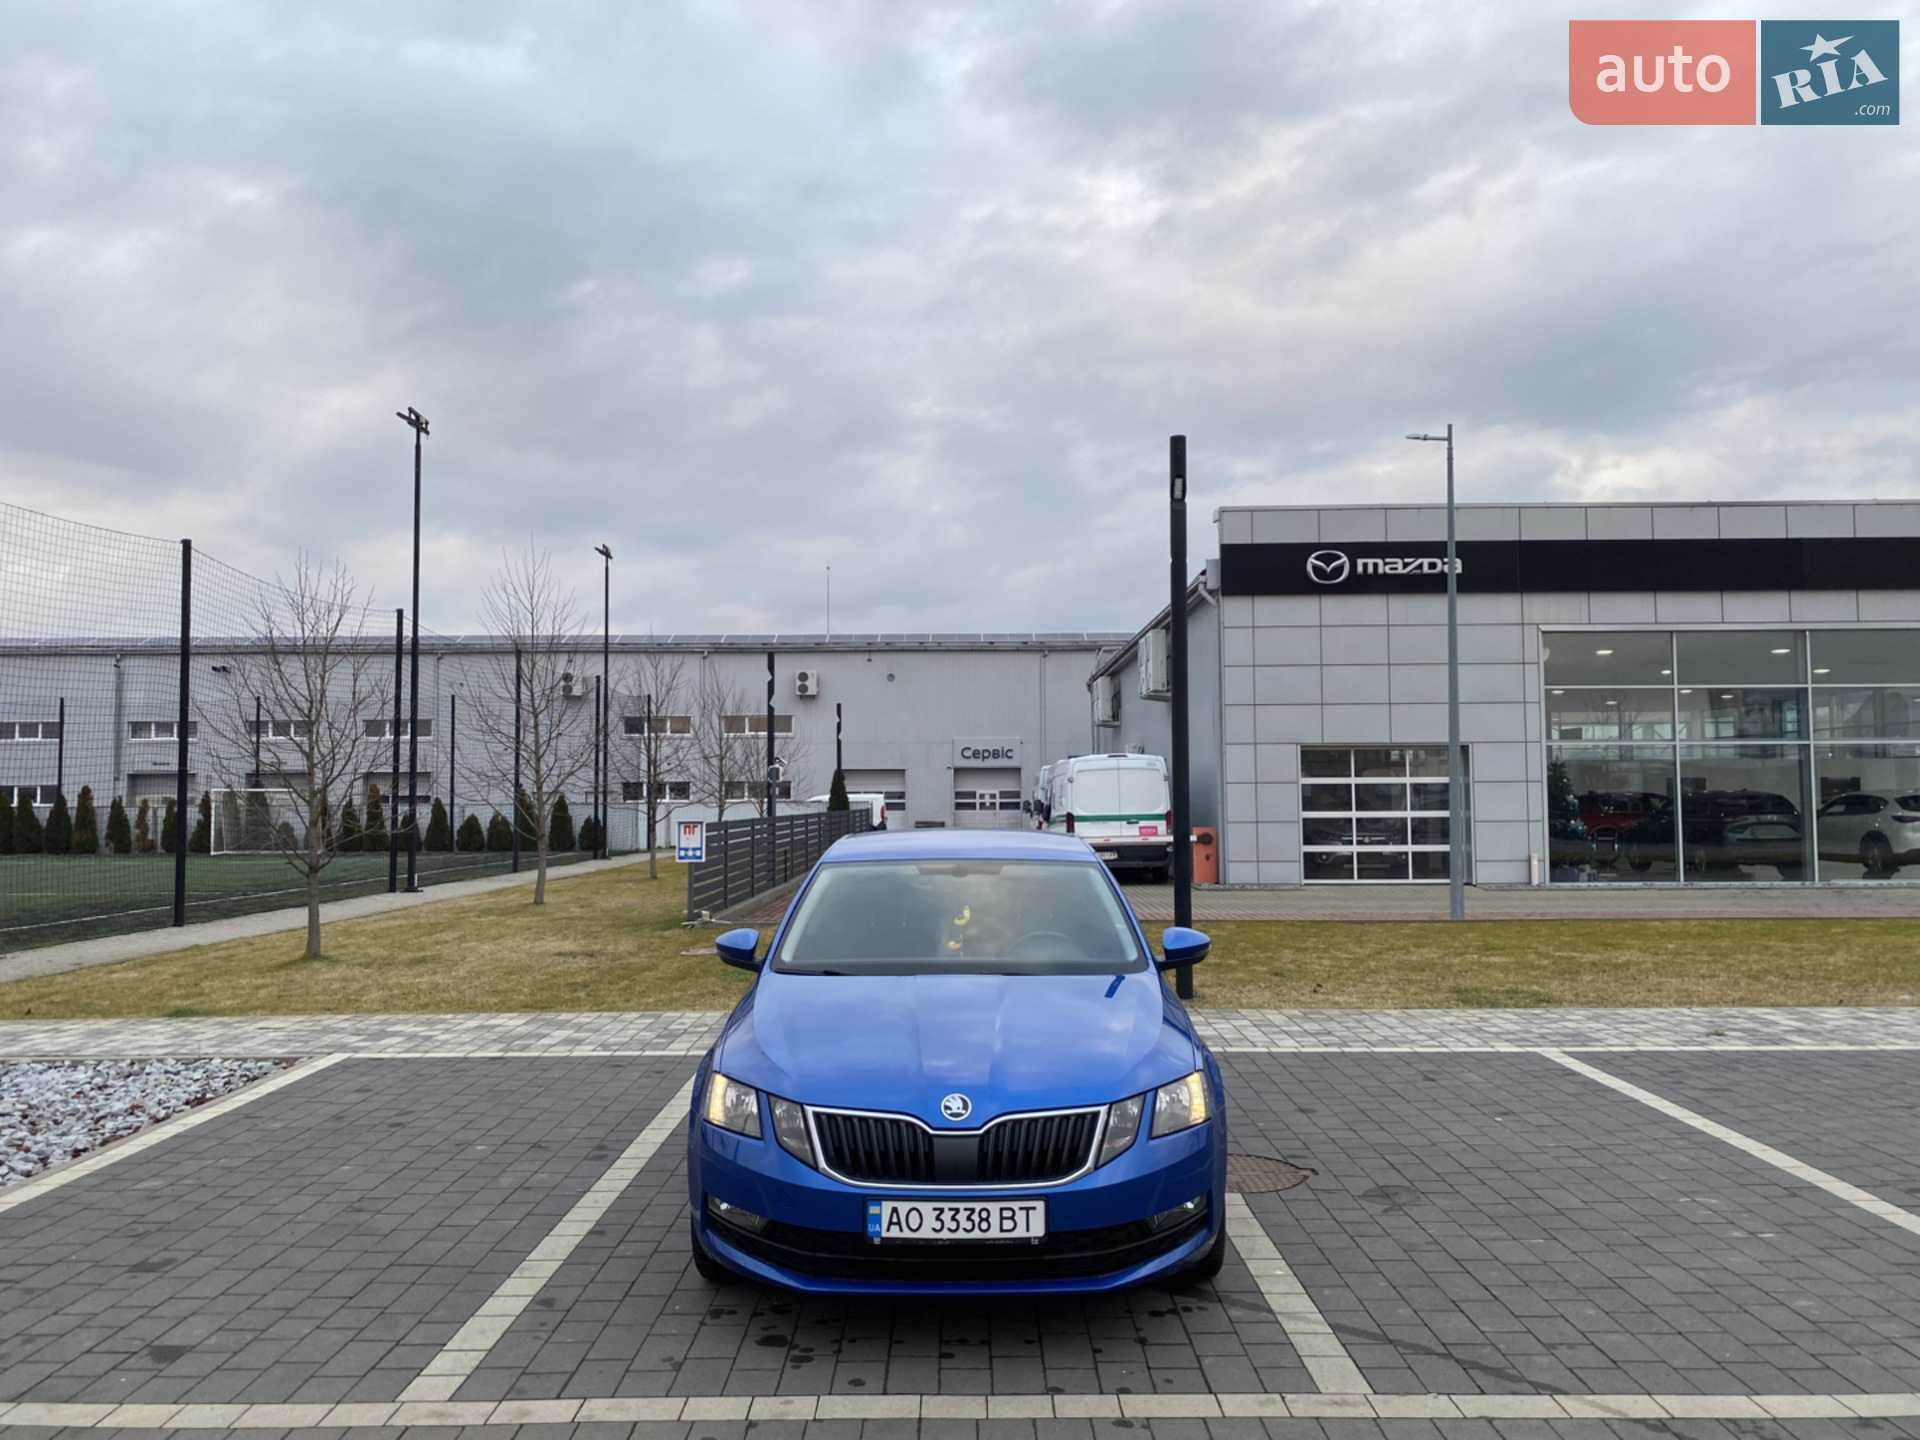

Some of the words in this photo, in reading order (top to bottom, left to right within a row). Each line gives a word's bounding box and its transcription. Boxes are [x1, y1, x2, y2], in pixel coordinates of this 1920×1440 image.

[961, 746, 1014, 762] Сервіс
[868, 1223, 881, 1232] UA
[886, 1206, 924, 1233] AO
[931, 1207, 991, 1233] 3338
[999, 1206, 1037, 1233] BT
